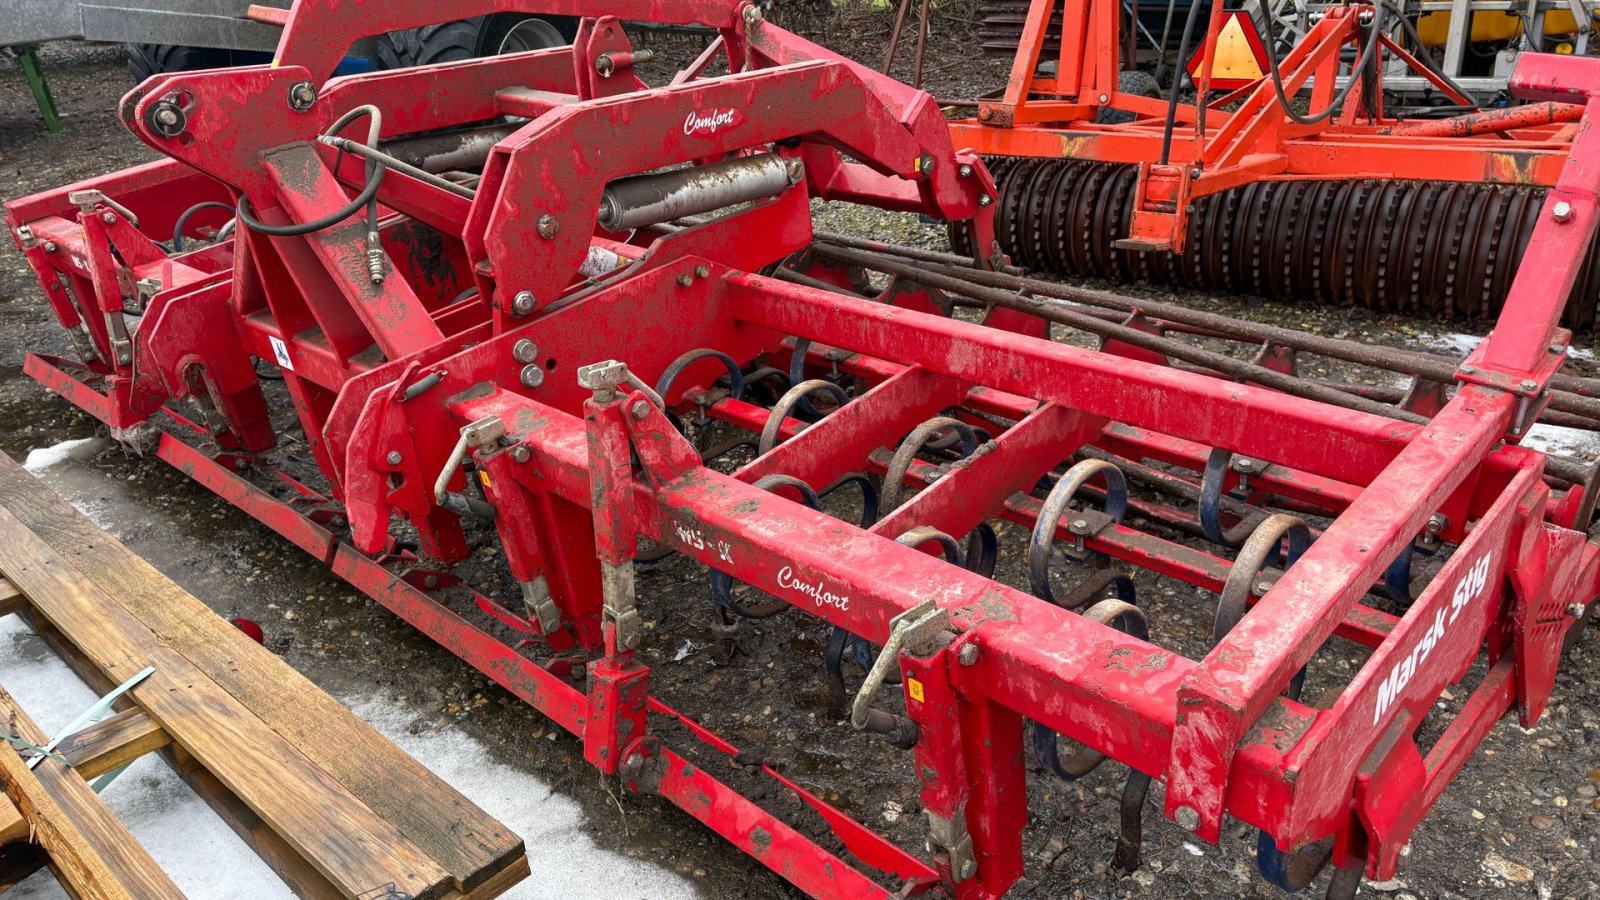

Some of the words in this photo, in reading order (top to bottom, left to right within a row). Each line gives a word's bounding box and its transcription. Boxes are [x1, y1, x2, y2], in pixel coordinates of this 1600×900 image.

[683, 107, 734, 135] Comfort
[777, 566, 850, 611] Comfort
[1373, 606, 1450, 727] Marsk
[1449, 549, 1491, 626] Stig
